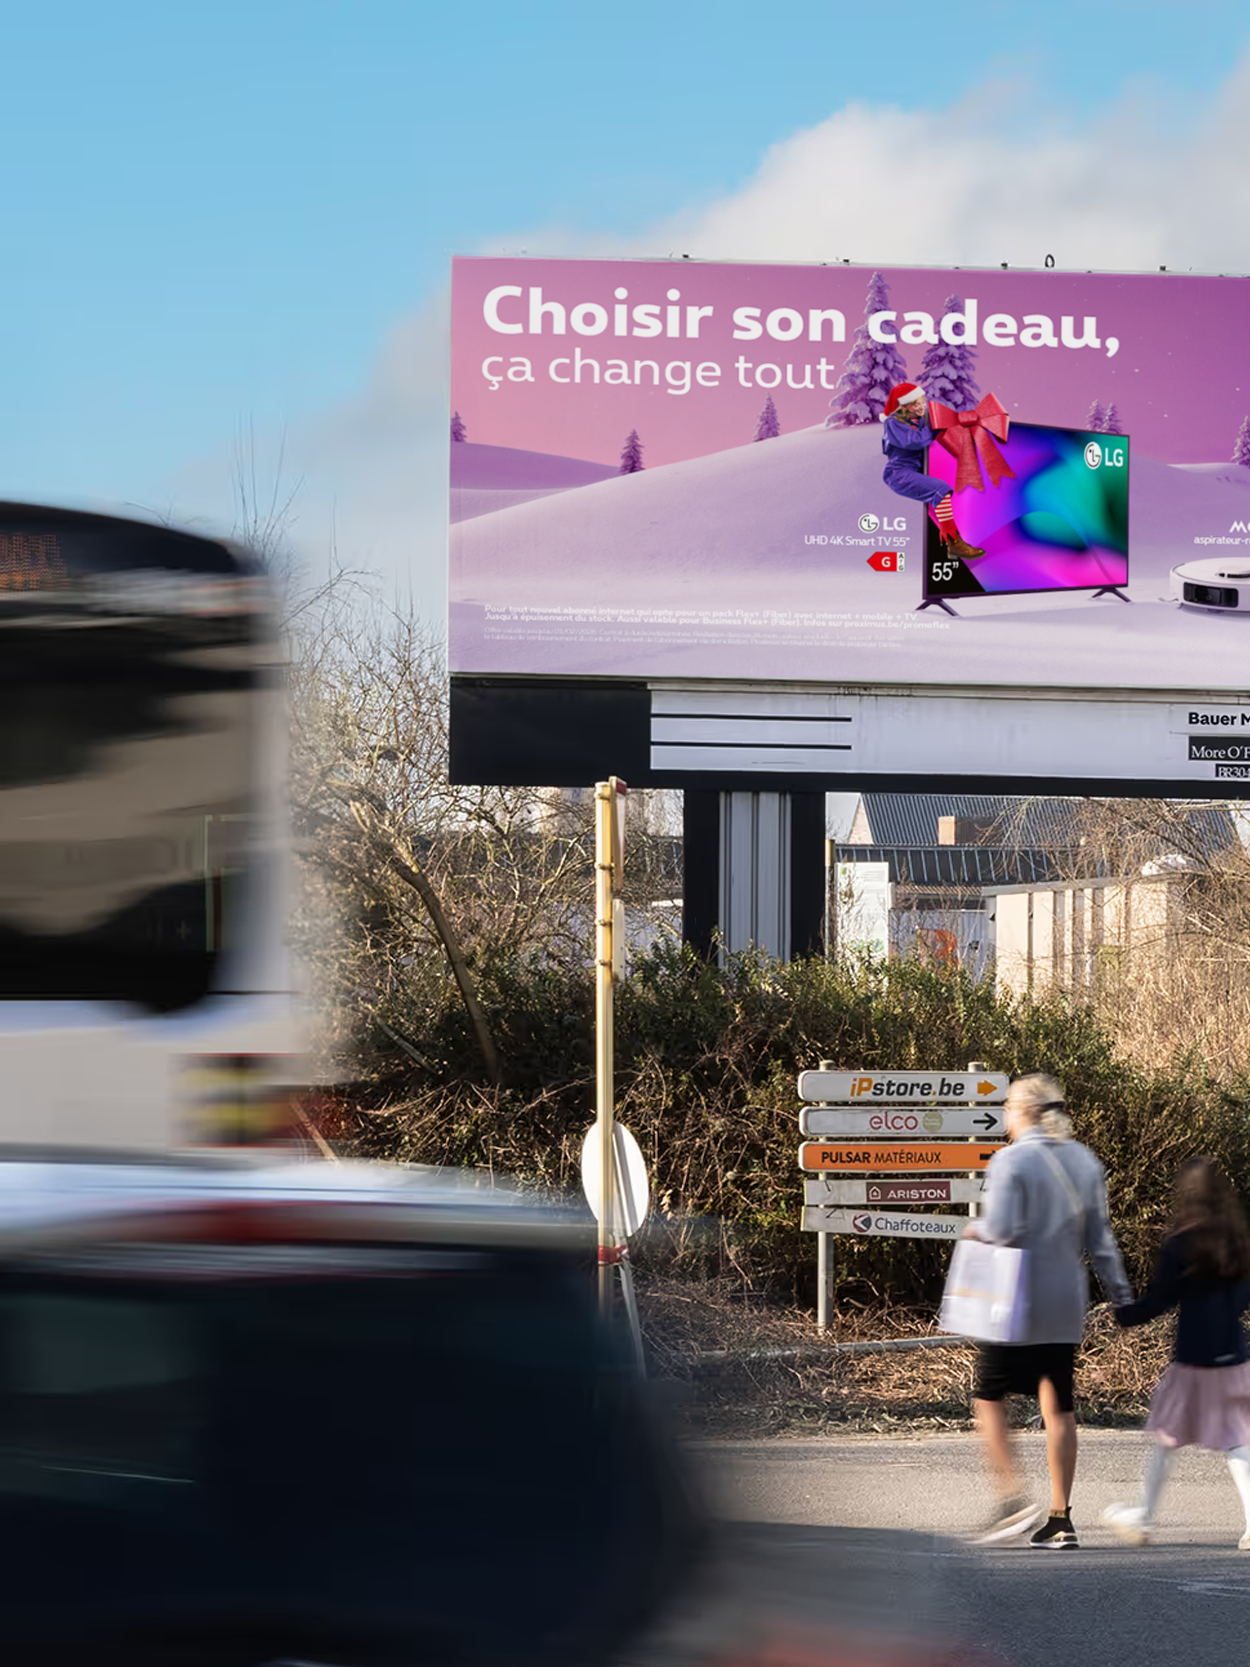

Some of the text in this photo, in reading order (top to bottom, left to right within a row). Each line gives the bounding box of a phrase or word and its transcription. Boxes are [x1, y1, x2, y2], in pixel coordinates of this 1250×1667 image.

[483, 285, 1120, 358] Choisir son cadeau,
[481, 347, 834, 394] ça change tout
[1104, 447, 1124, 467] LG
[883, 517, 907, 531] LG
[804, 535, 828, 545] UHD
[830, 536, 844, 546] 4K
[846, 536, 875, 547] Smart
[877, 537, 891, 546] TV
[881, 557, 891, 568] G
[485, 604, 506, 613] Pour
[509, 605, 527, 614] tout
[530, 606, 560, 615] nouvel
[1188, 712, 1237, 726] Bauer
[1191, 745, 1226, 759] More
[850, 1077, 965, 1098] iPstore.be
[869, 1111, 919, 1130] elco
[821, 1149, 942, 1164] PULSAR MATÉRIAUX
[887, 1188, 947, 1199] ARISTON
[874, 1216, 956, 1234] Chaffoteaux
